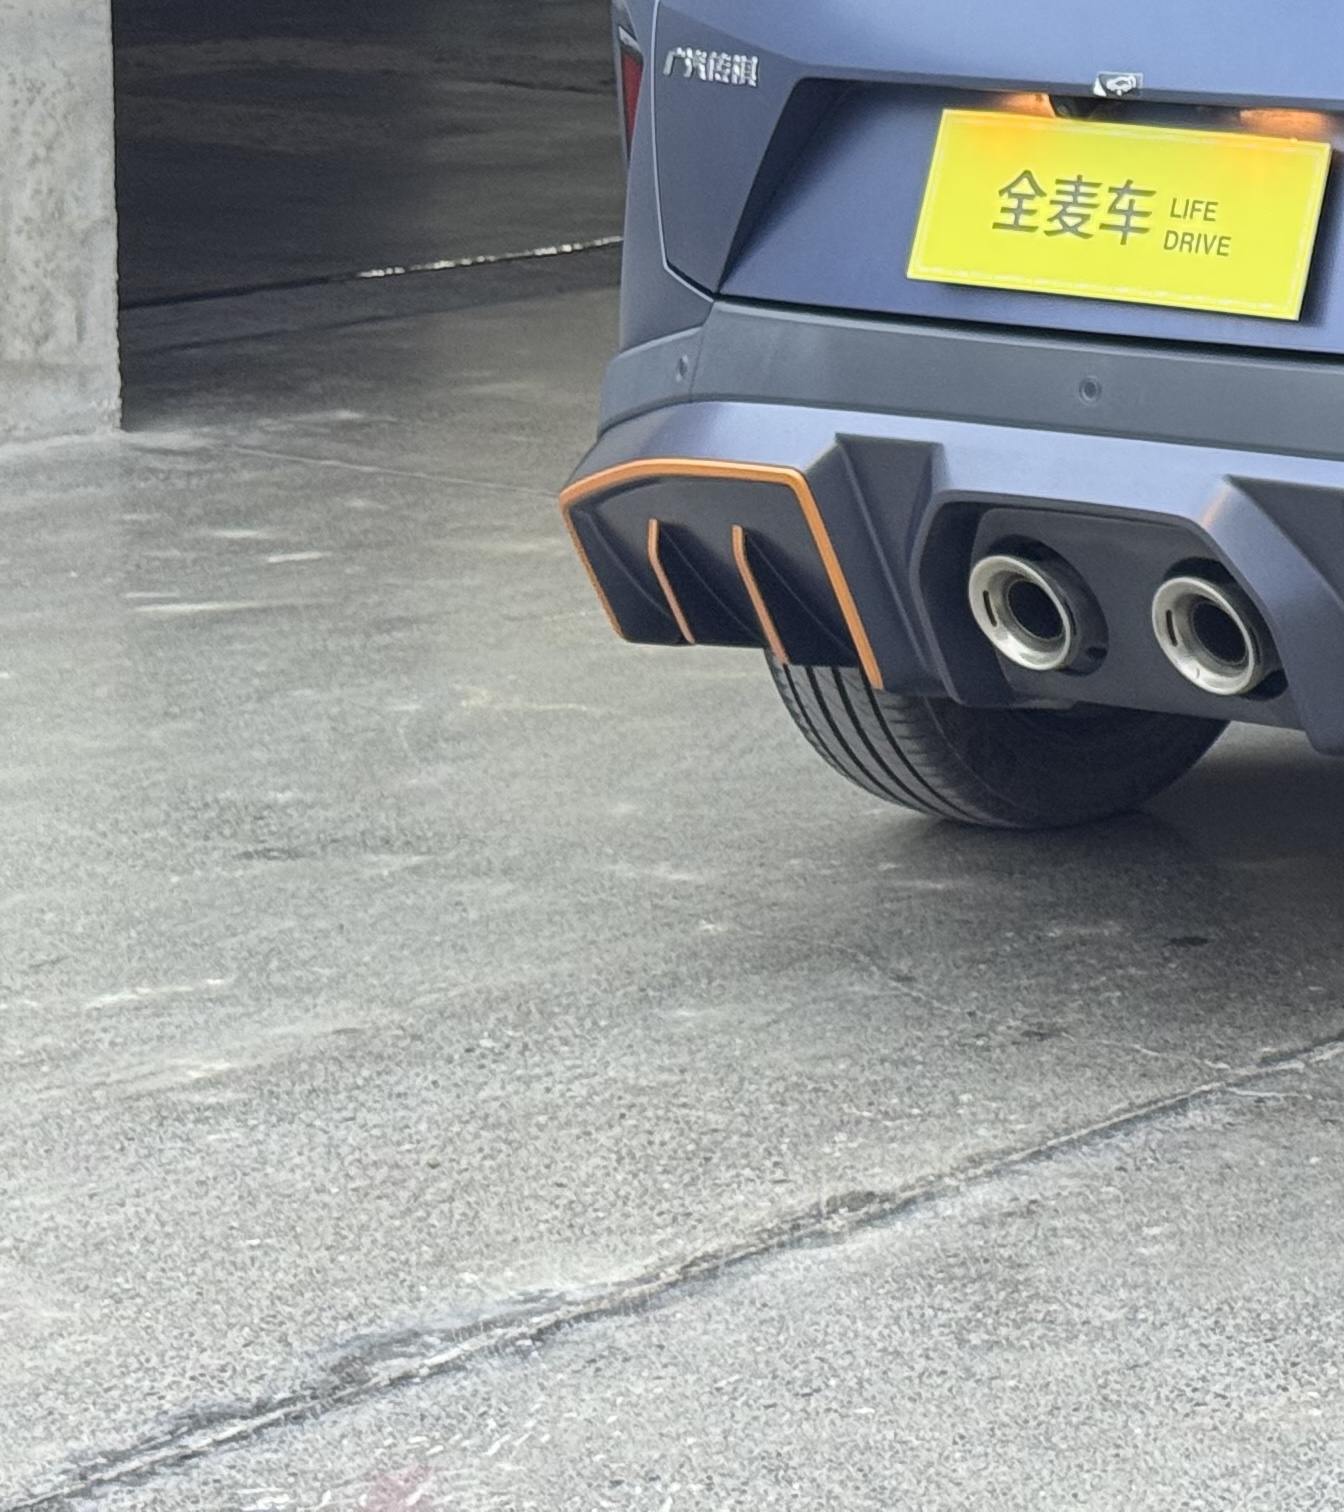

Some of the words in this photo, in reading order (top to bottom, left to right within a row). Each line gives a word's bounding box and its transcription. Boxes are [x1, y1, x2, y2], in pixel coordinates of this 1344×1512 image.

[991, 168, 1158, 246] 全麦车
[1169, 197, 1219, 223] LIFE
[1162, 229, 1233, 258] DRIVE
